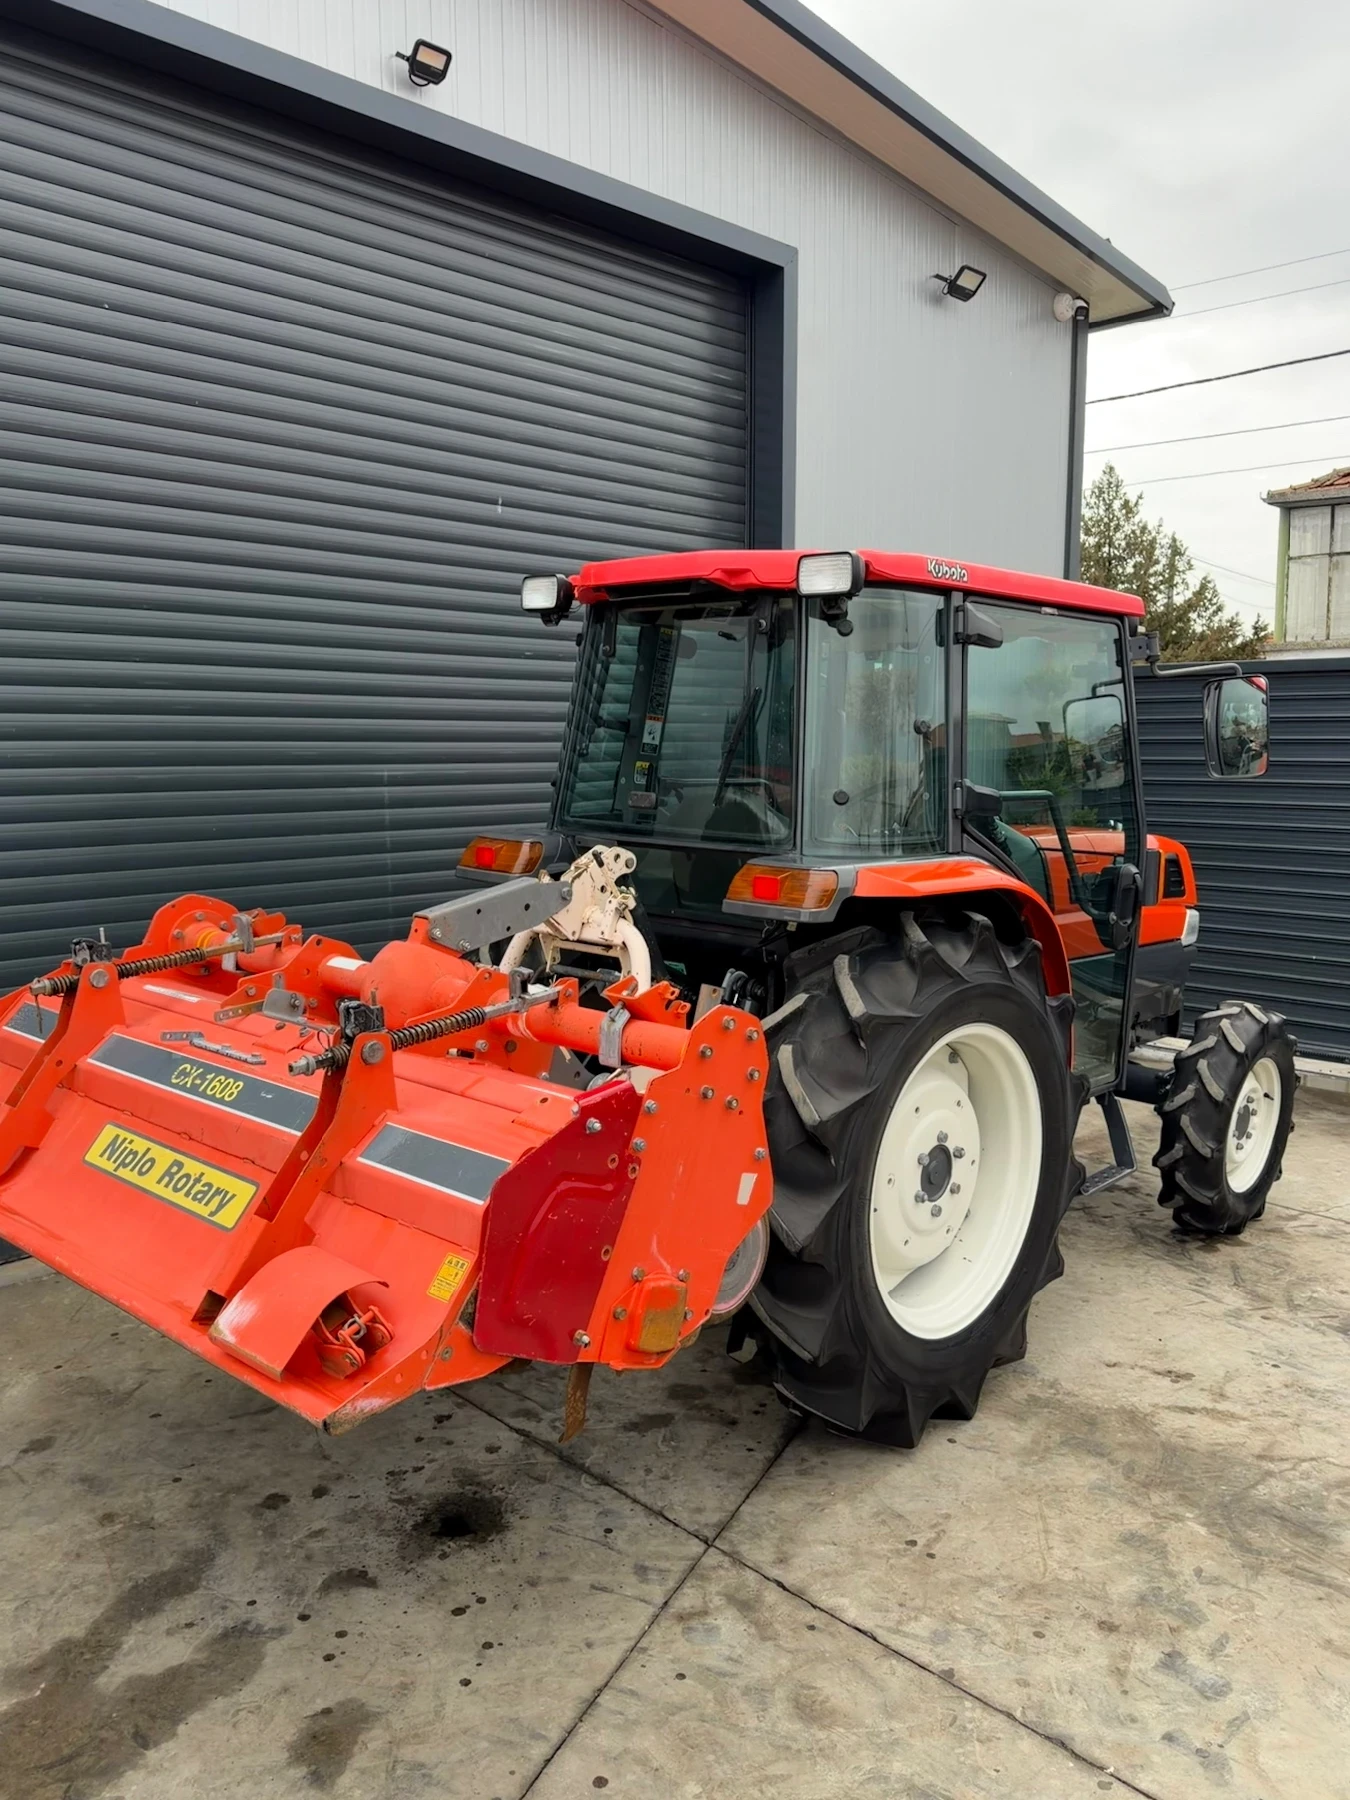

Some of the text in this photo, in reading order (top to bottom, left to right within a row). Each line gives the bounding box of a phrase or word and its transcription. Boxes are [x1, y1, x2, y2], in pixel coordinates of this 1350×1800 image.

[927, 558, 968, 582] Kubota
[170, 1063, 244, 1101] CX-1608
[99, 1133, 237, 1218] Niplo Rotary
